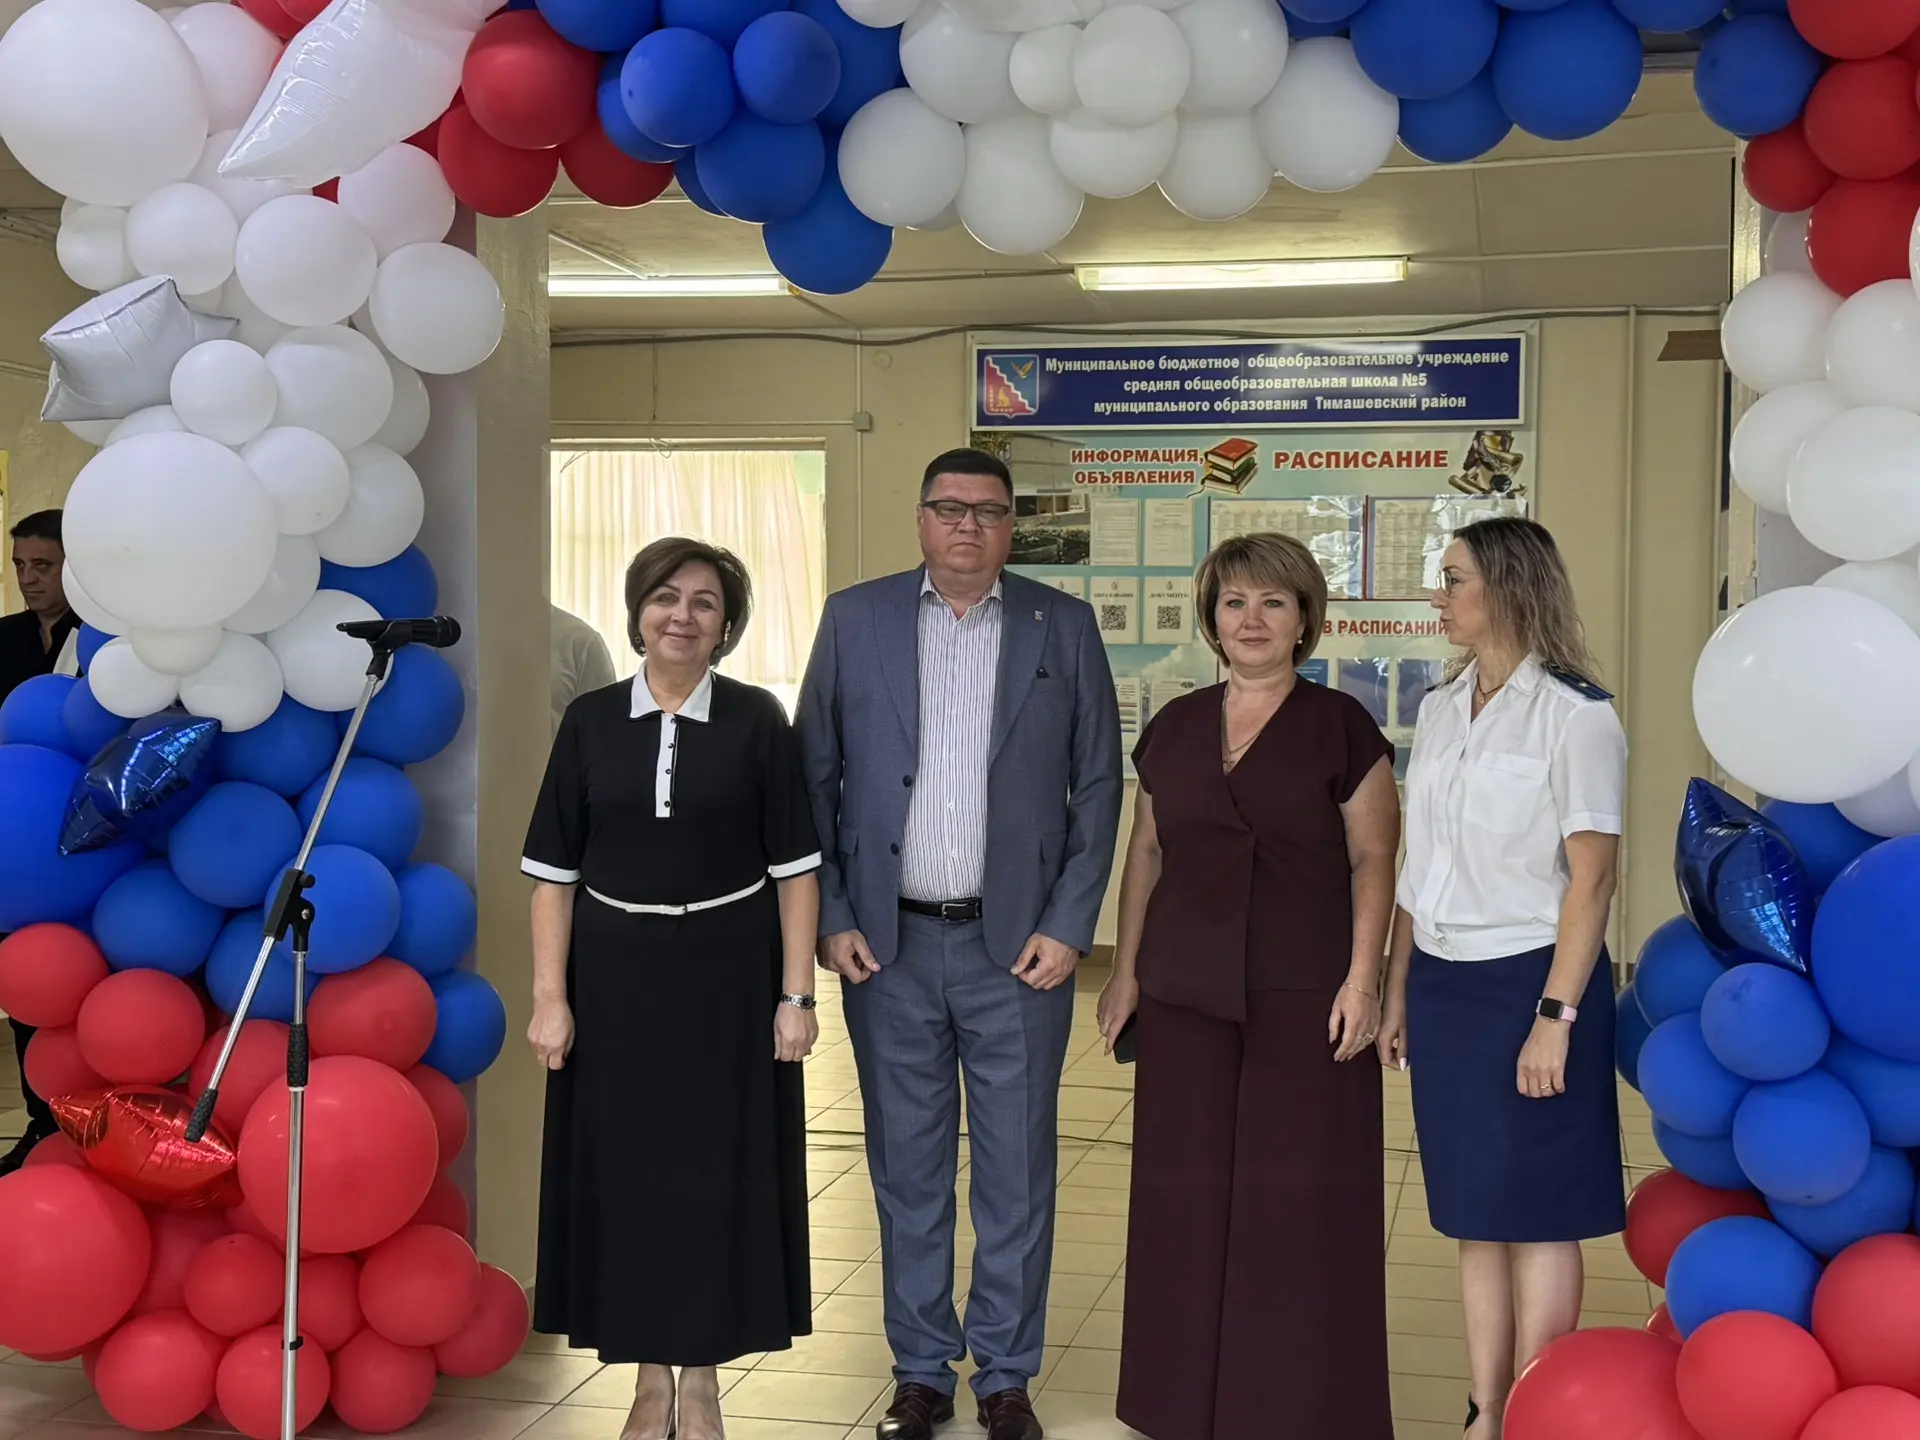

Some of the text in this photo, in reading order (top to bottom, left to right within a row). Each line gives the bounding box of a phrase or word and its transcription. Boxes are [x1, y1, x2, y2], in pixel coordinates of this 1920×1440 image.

[1045, 350, 1509, 373] Муниципальное бюджетное общеобразовательное учреждение
[1123, 372, 1428, 393] средняя общеобразовательная школа №5
[1093, 393, 1467, 415] муниципального образования Тимашевский район
[1071, 448, 1204, 465] ИНФОРМАЦИЯ,
[1274, 450, 1448, 469] РАСПИСАНИЕ
[1075, 470, 1195, 485] ОБЪЯВЛЕНИЯ
